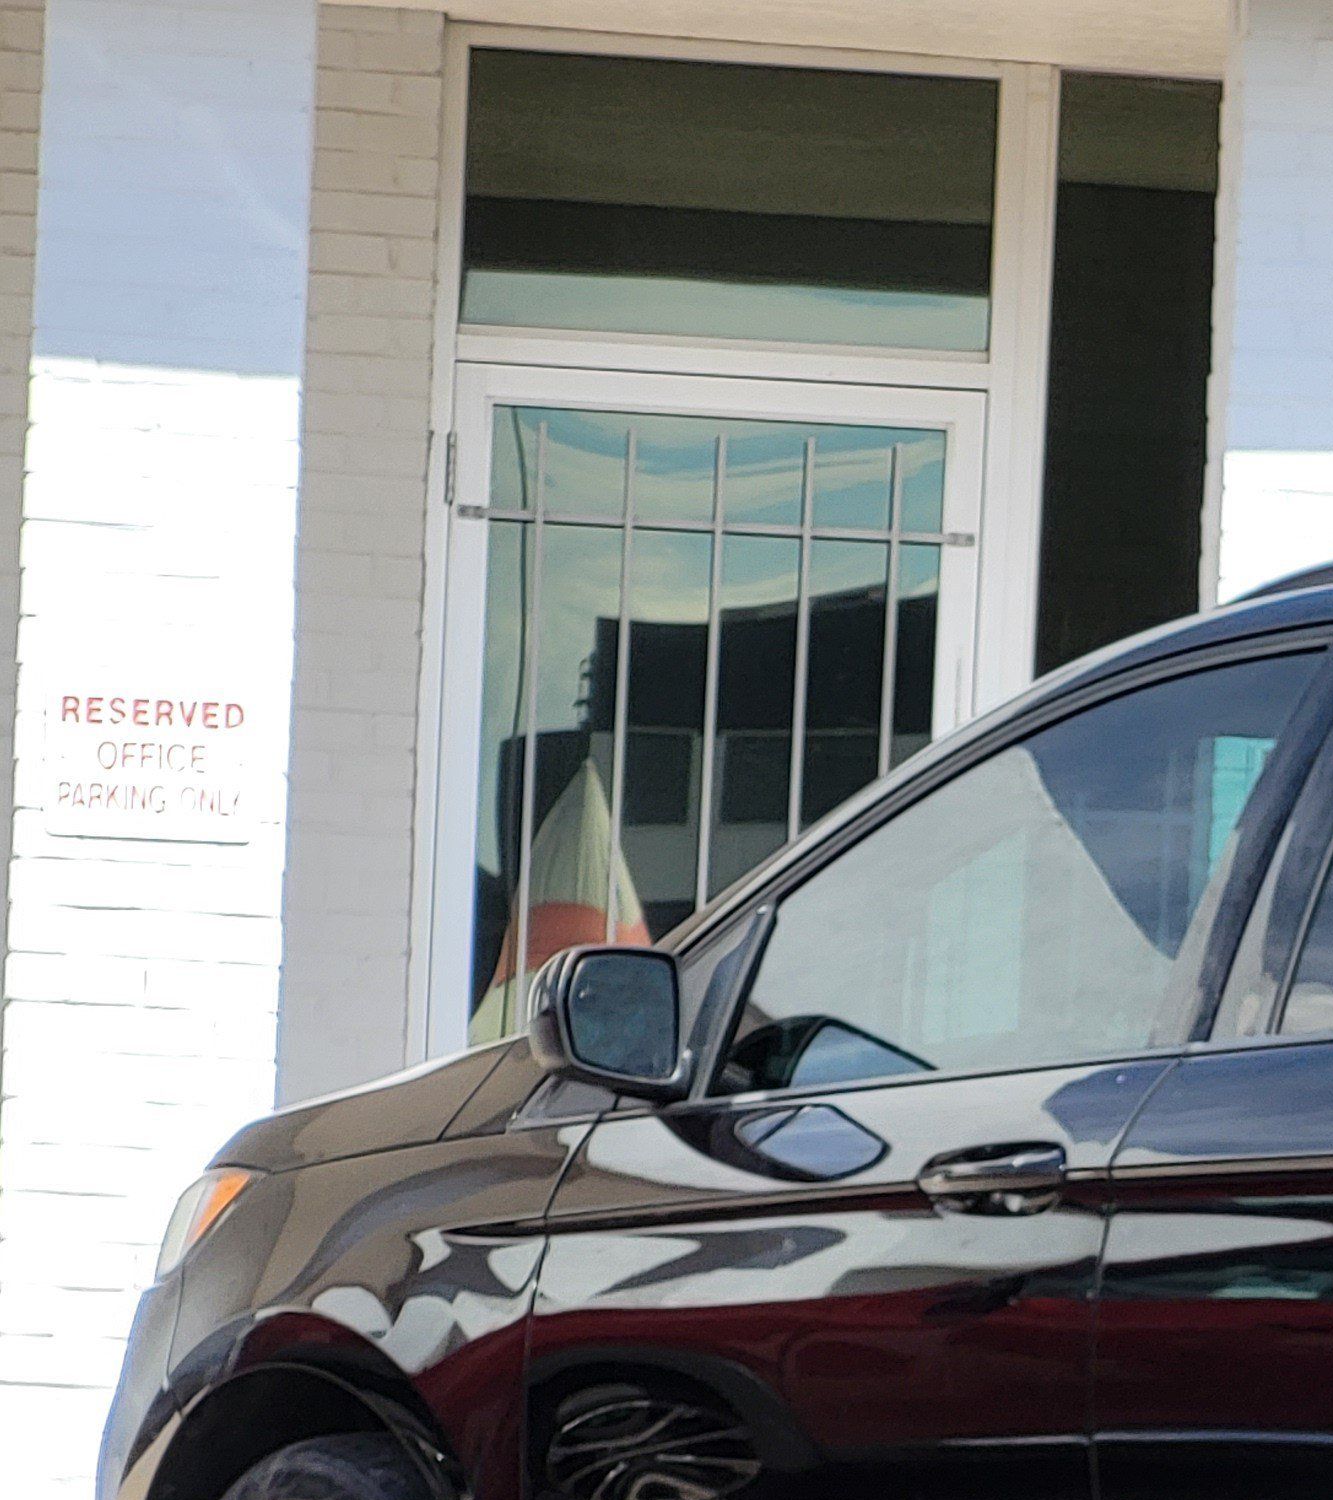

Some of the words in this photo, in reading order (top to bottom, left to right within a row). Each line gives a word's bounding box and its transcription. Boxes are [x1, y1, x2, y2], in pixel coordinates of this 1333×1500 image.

[61, 696, 244, 729] RESERVED
[97, 741, 206, 773] OFFICE
[57, 781, 165, 813] PARKING
